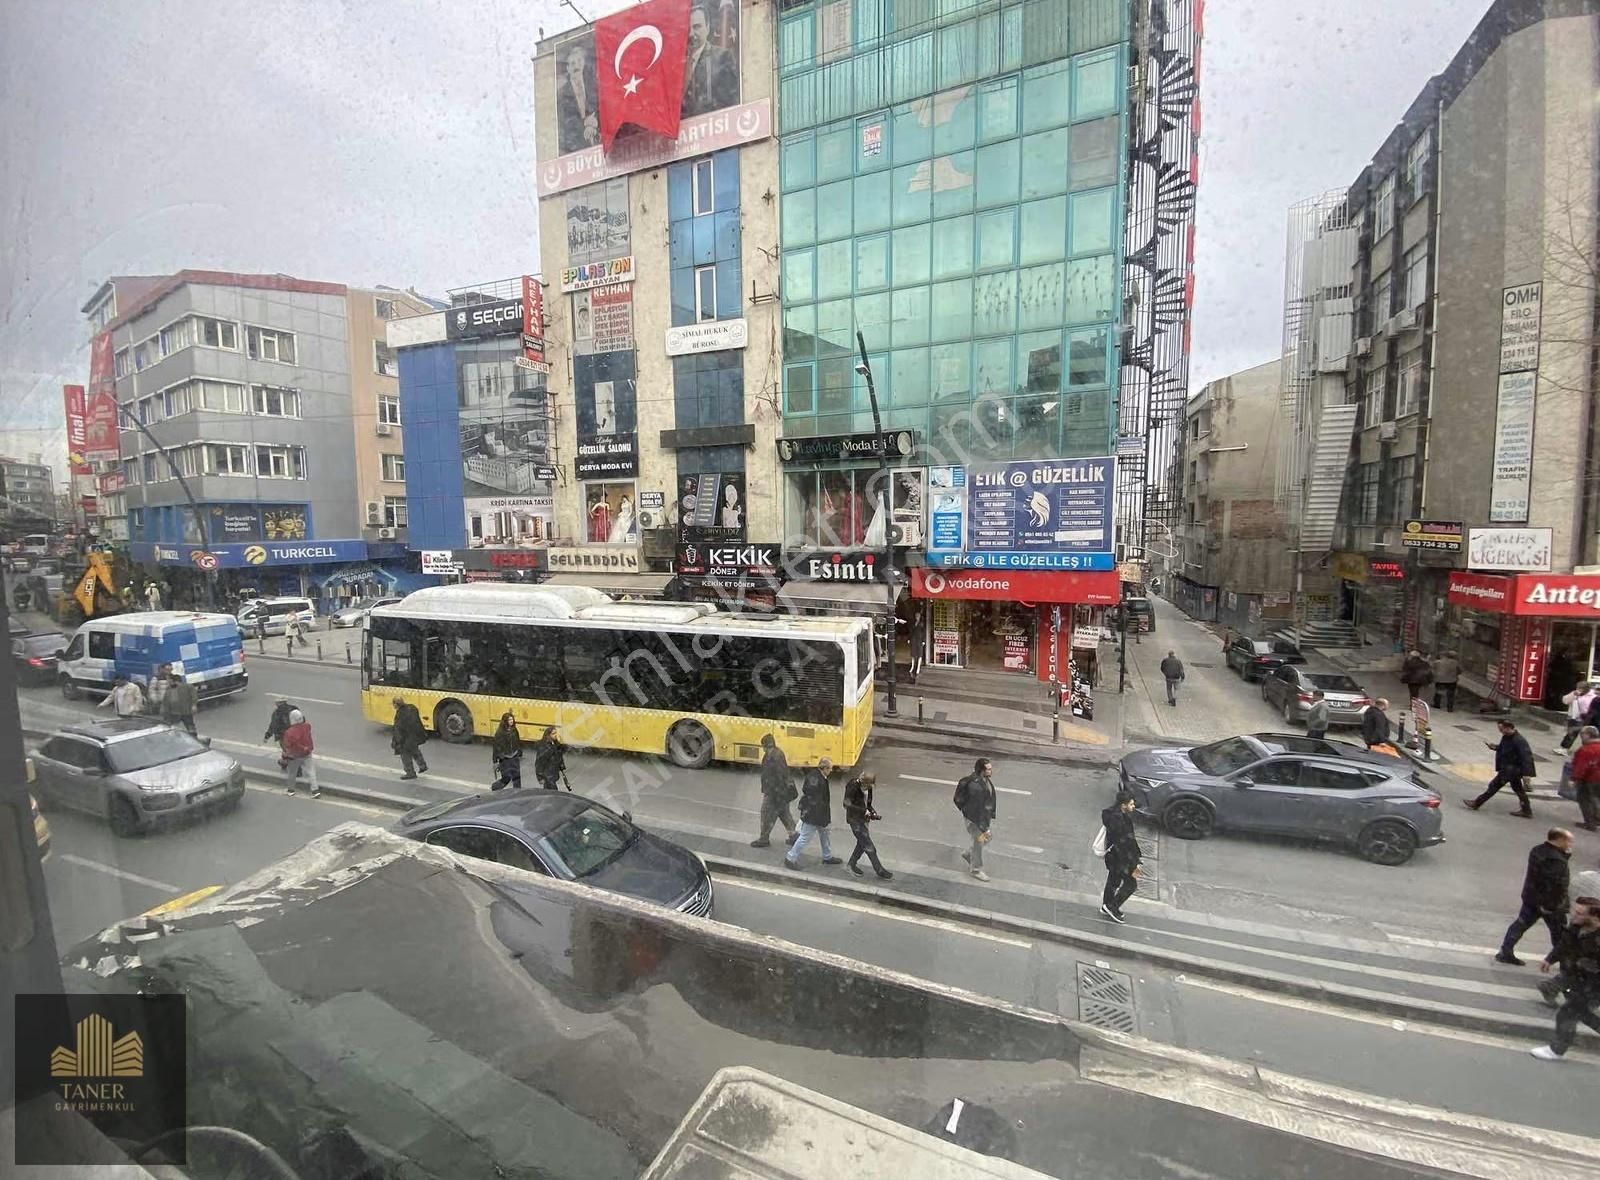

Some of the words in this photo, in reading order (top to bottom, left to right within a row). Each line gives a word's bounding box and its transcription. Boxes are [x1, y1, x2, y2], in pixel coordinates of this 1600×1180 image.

[567, 149, 607, 175] BÜYÜ
[676, 114, 729, 144] ARTİSİ
[593, 276, 620, 286] BAYAN
[593, 283, 630, 297] REYHAN
[1505, 287, 1539, 305] OMH
[529, 280, 539, 336] REYHAN
[69, 413, 86, 446] final
[579, 444, 605, 455] GÜZELLİK
[608, 443, 631, 453] SALONU
[843, 439, 872, 452] Moda
[872, 440, 887, 450] Ei
[1010, 471, 1028, 487] @
[1032, 463, 1105, 484] GÜZELLİK
[272, 547, 336, 560] TURKCELL
[709, 545, 772, 565] KEKİK
[944, 554, 970, 566] ETİK
[973, 555, 985, 567] @
[989, 554, 1006, 565] İLE
[1011, 554, 1079, 568] GÜZELLEŞ
[1083, 555, 1092, 567] !!
[710, 566, 737, 575] DÖNER
[810, 553, 875, 580] Esinti
[84, 579, 94, 599] JCB
[949, 577, 1010, 591] vodafone
